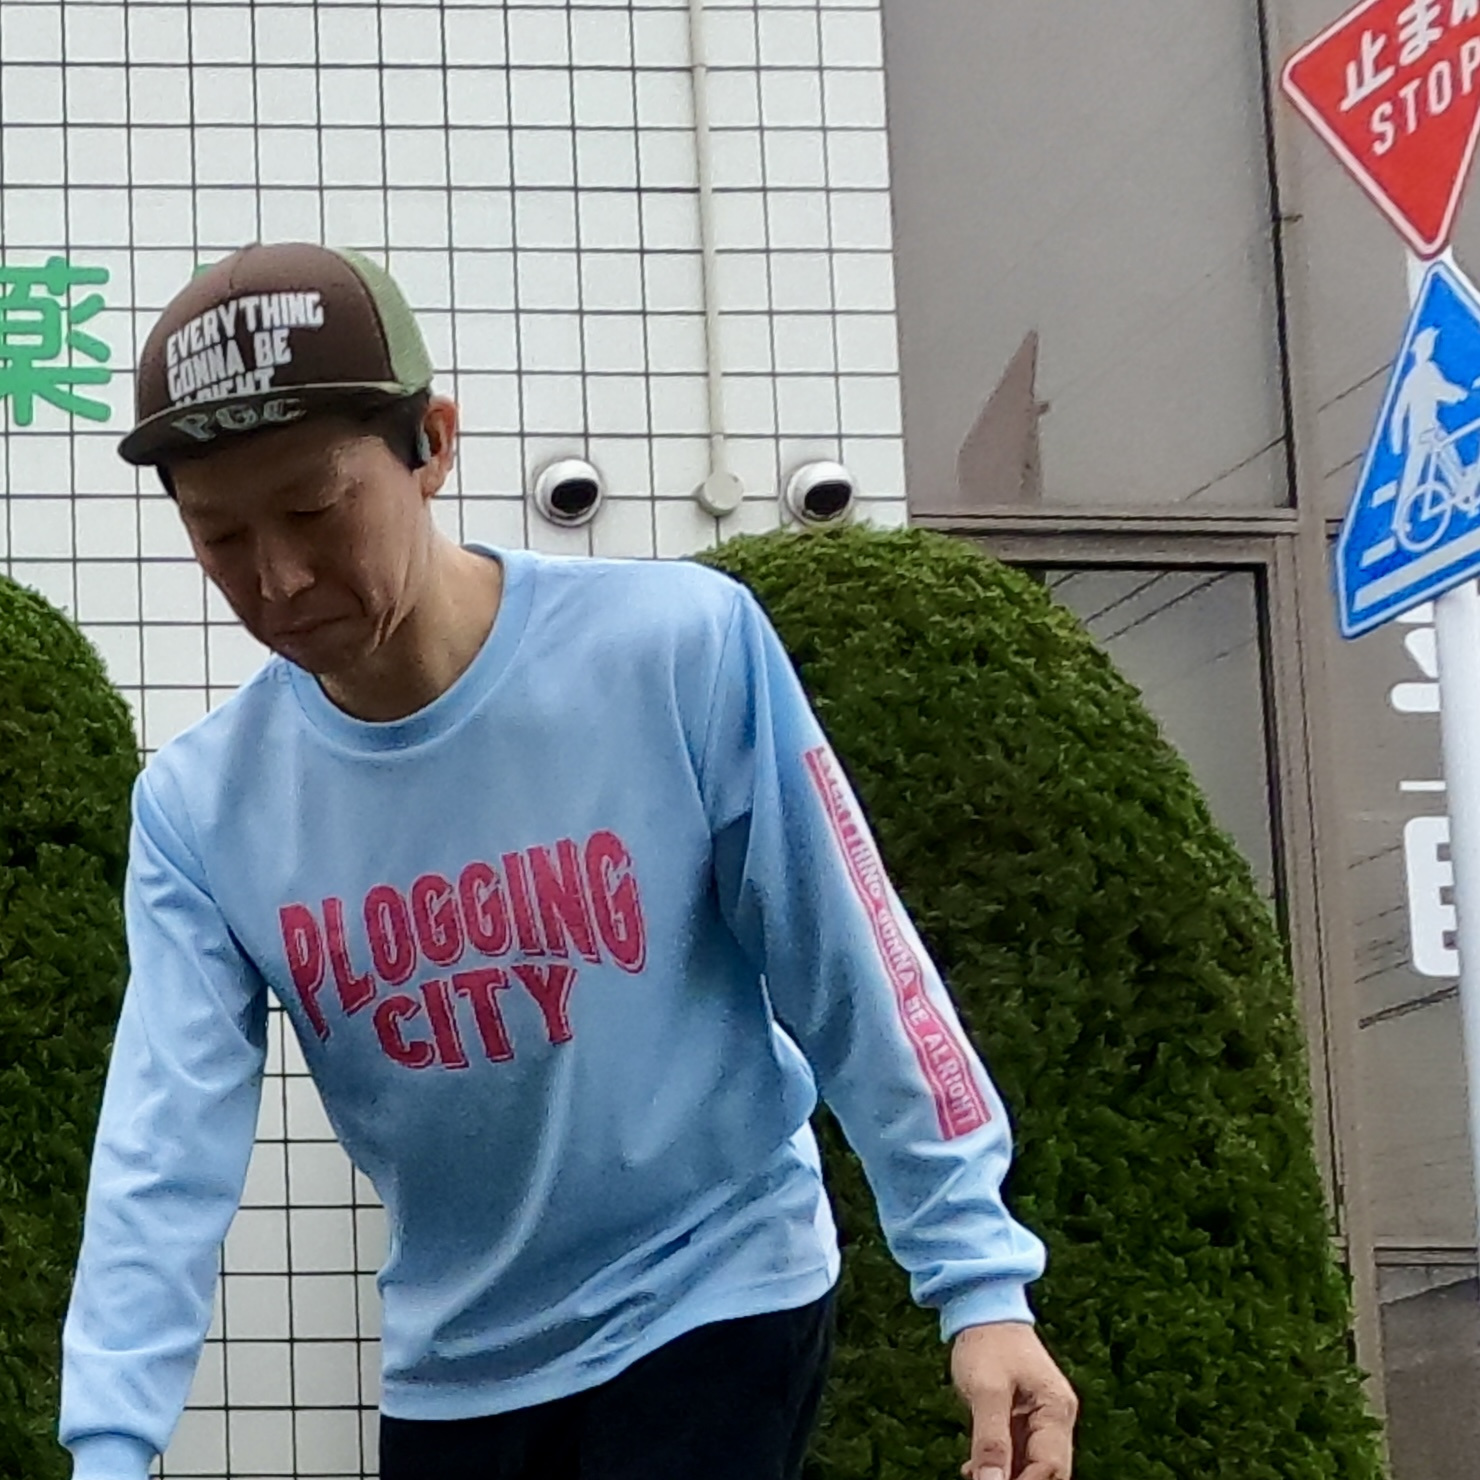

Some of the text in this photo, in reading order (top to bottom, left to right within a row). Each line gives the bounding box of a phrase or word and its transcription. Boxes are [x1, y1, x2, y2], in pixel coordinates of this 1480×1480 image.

[1371, 36, 1480, 156] STOP
[166, 291, 324, 369] EVERYTHING
[167, 328, 292, 401] GONNA BE
[175, 366, 275, 407] IGHT
[277, 827, 647, 1042] PLOGGING
[372, 960, 578, 1070] CITY
[922, 1032, 981, 1127] ALRIGHT
